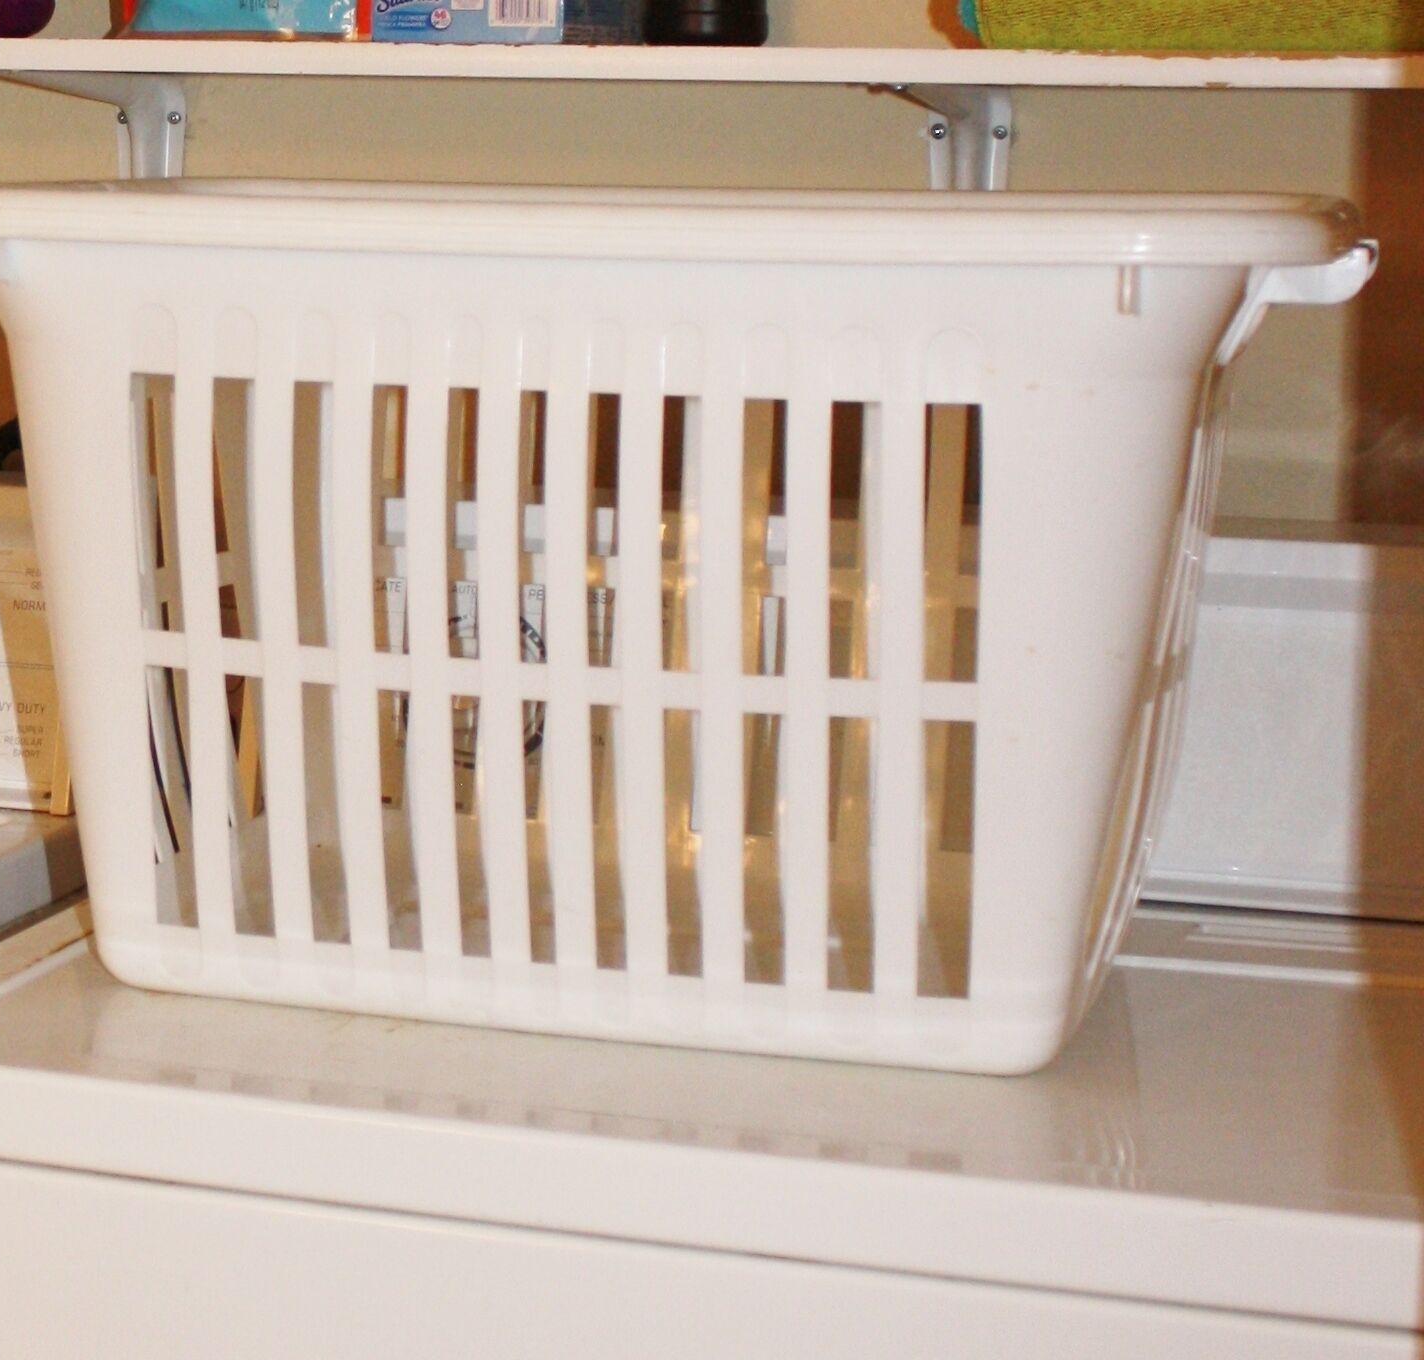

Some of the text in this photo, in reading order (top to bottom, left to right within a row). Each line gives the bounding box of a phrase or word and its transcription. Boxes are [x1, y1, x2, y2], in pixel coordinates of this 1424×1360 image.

[16, 703, 45, 715] DUTY
[4, 735, 42, 746] REGULAR
[13, 749, 40, 759] SHORT
